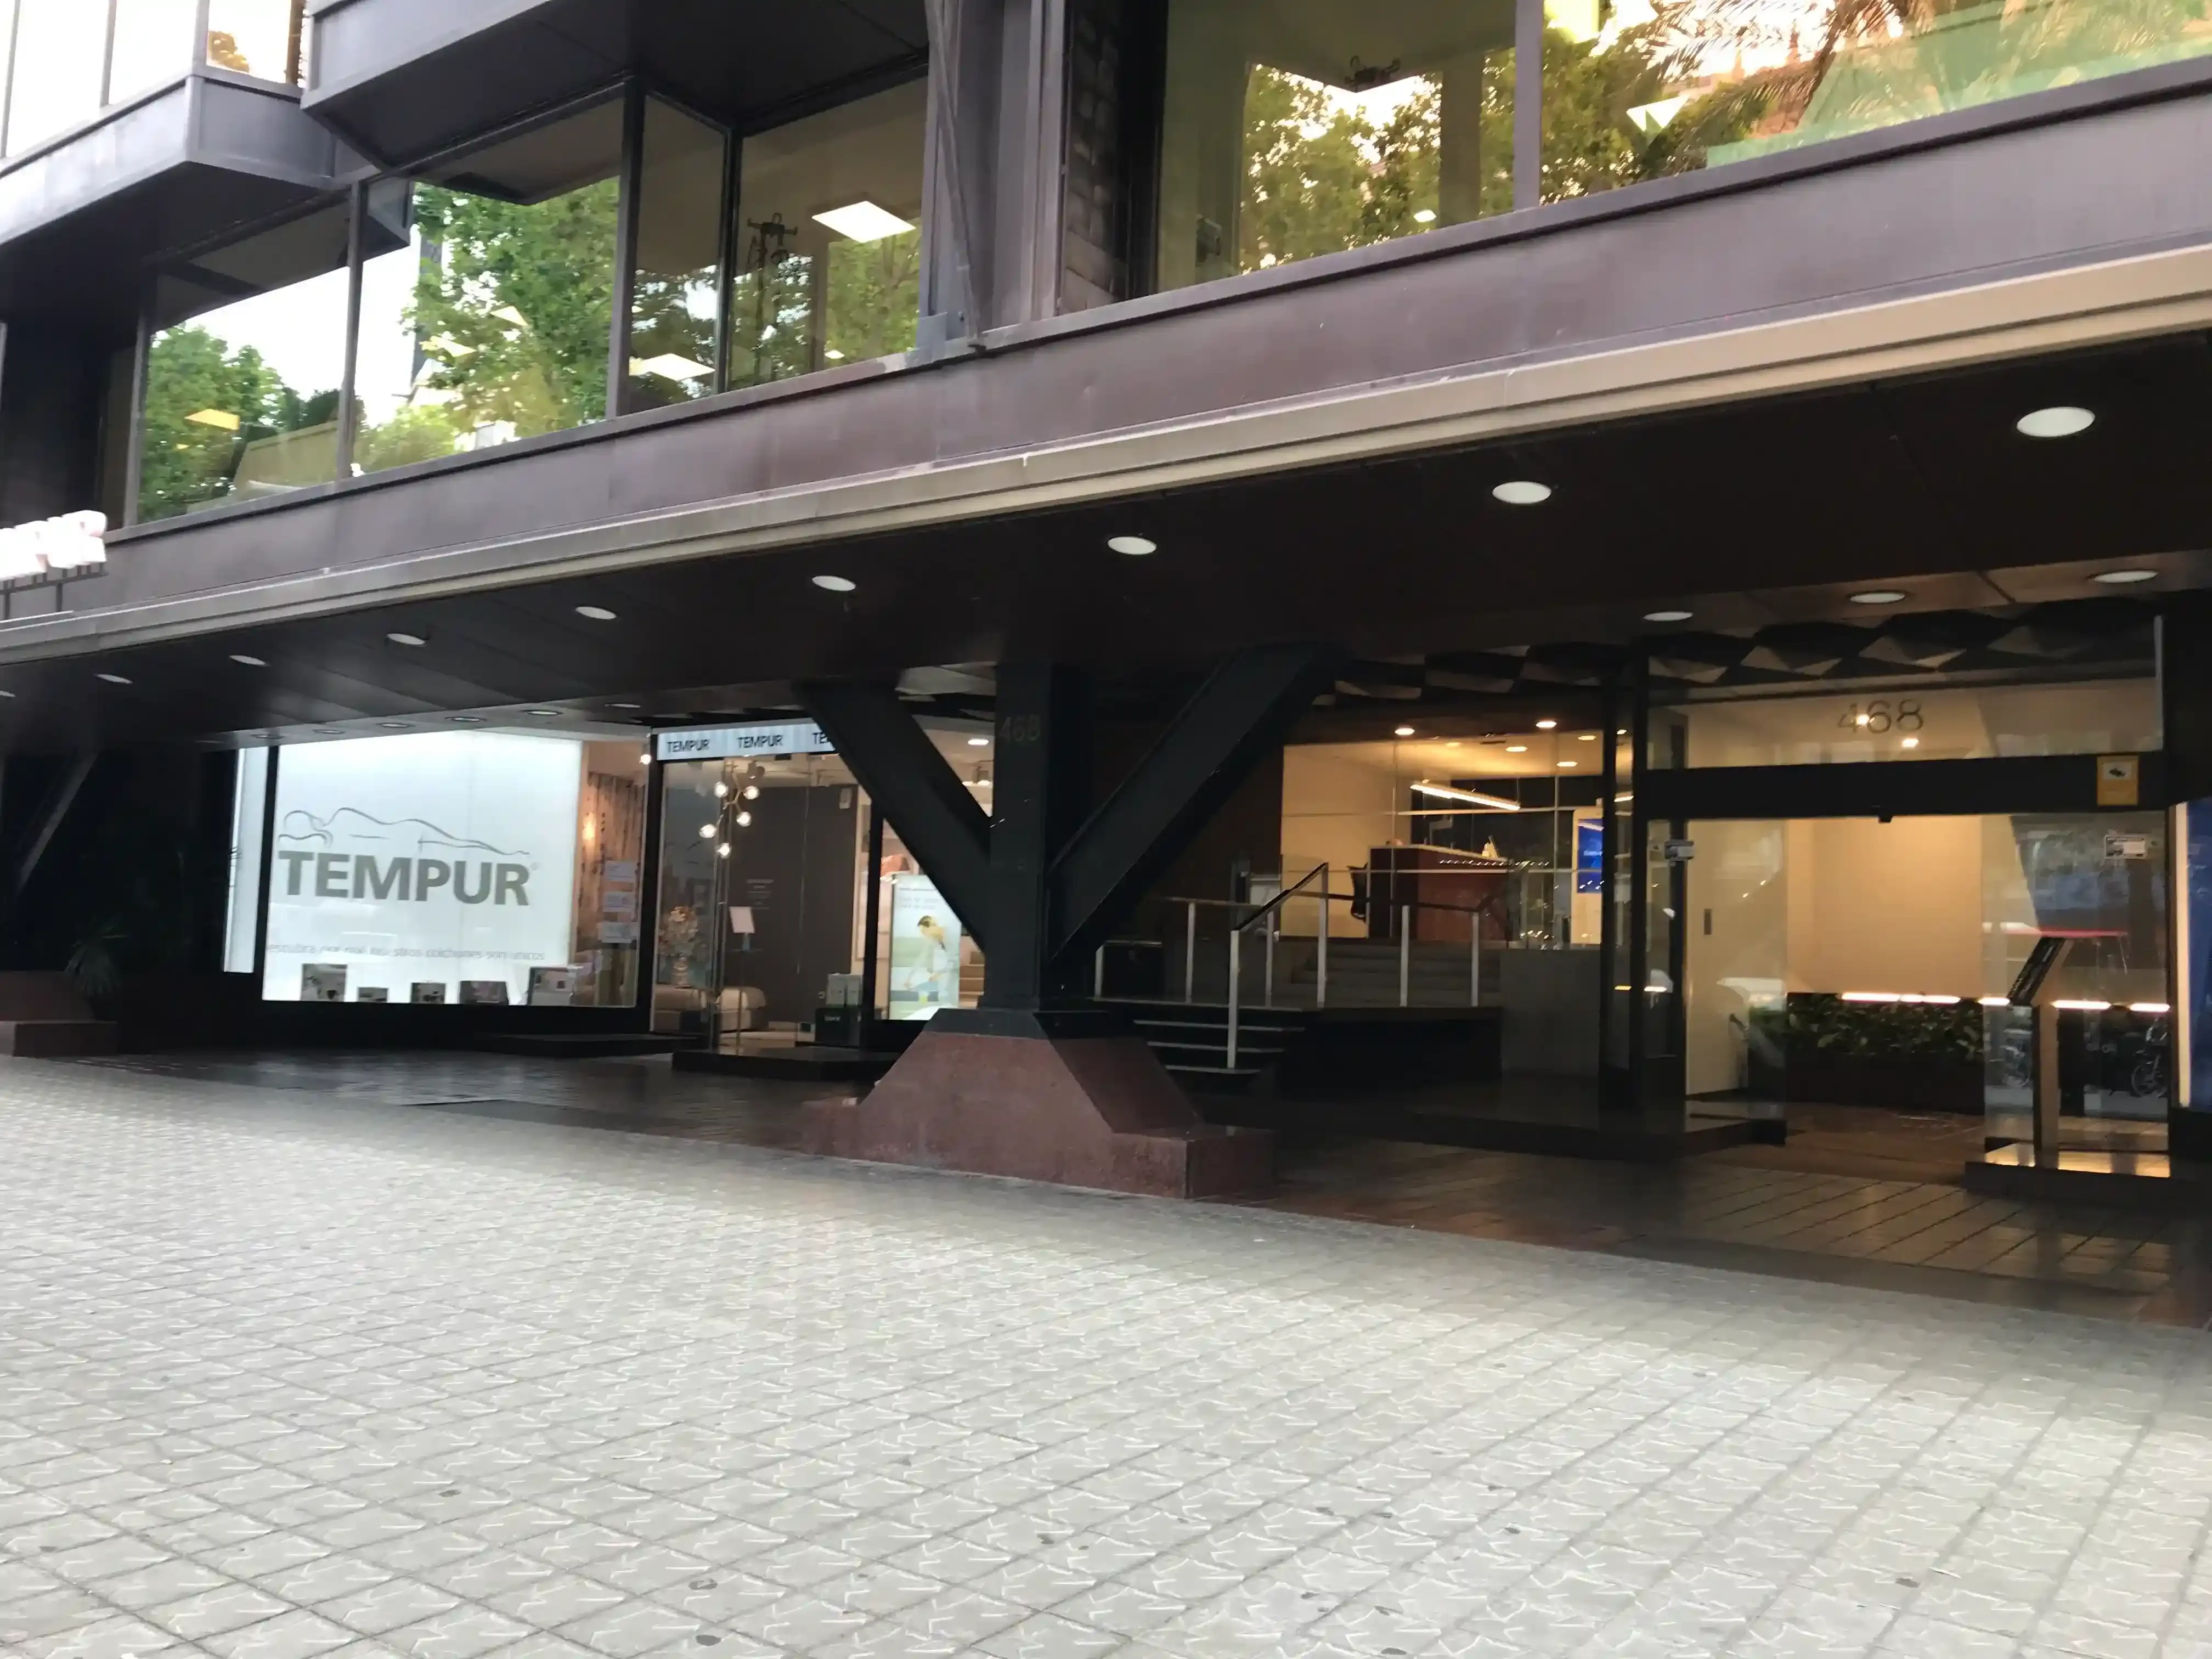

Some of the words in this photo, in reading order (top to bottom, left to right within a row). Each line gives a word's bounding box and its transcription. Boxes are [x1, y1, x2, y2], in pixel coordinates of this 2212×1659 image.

[999, 714, 1041, 742] 468
[1837, 699, 1924, 734] 468
[667, 739, 710, 753] TEMPUR
[737, 735, 784, 749] TEMPUR
[278, 850, 531, 906] TEMPUR
